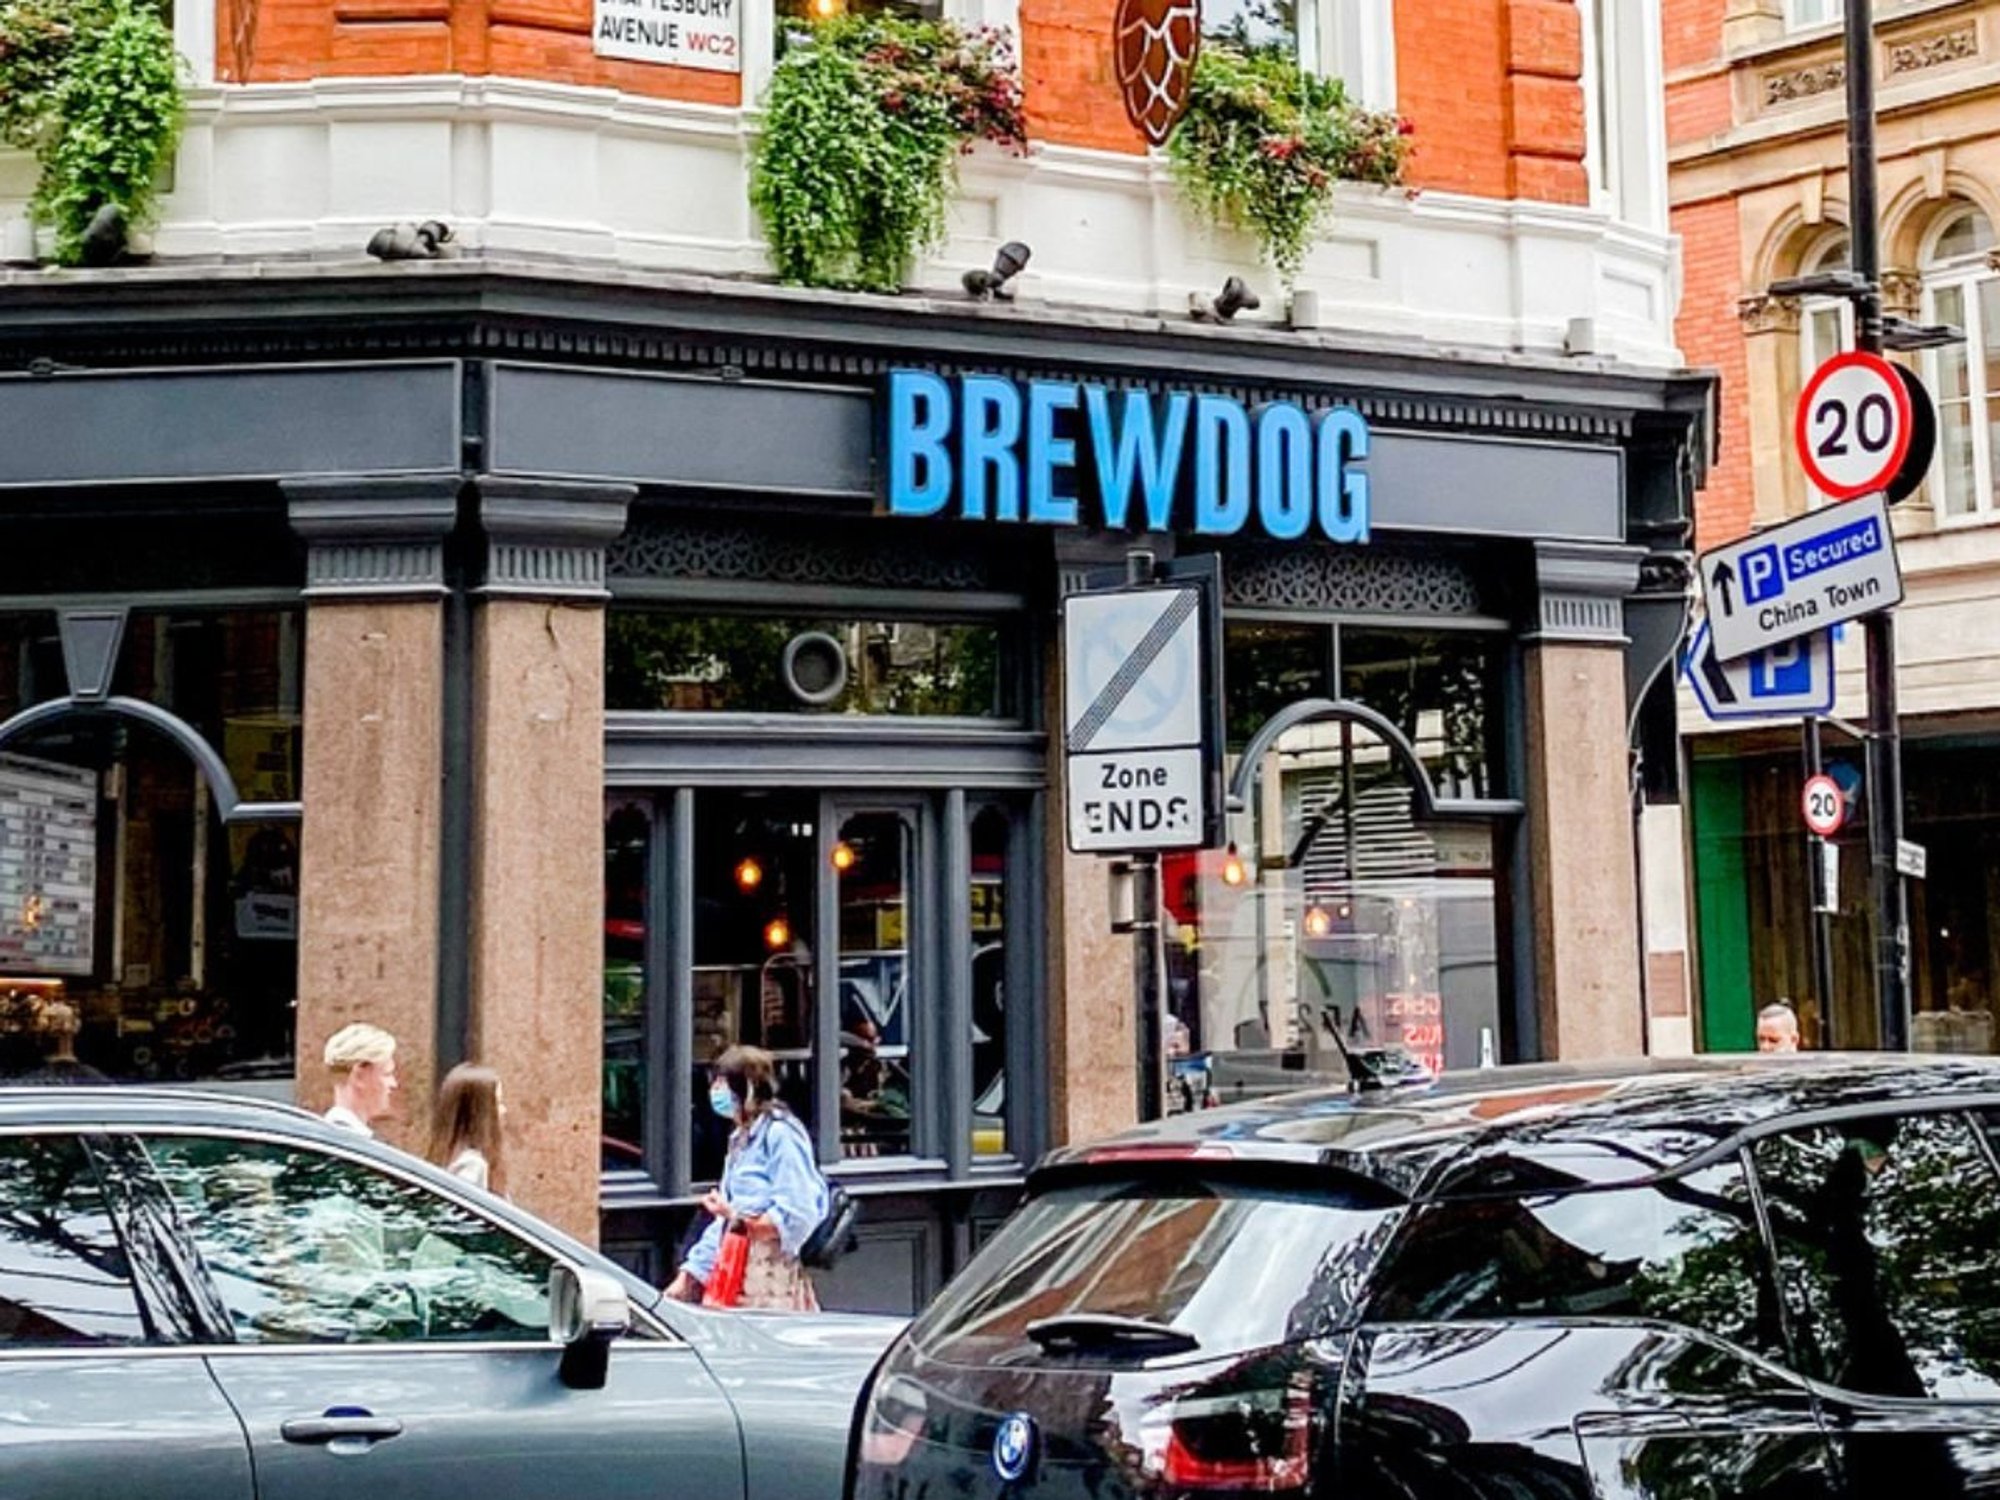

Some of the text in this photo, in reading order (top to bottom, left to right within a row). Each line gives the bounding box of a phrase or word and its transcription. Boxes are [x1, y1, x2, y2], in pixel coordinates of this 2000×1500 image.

[599, 15, 737, 57] AVENUE WC2
[1815, 393, 1893, 458] 20
[889, 368, 1370, 544] BREWDOG
[1749, 523, 1877, 598] P Secured
[1758, 575, 1881, 631] China Town
[1101, 763, 1168, 788] Zone
[1810, 793, 1836, 817] 20
